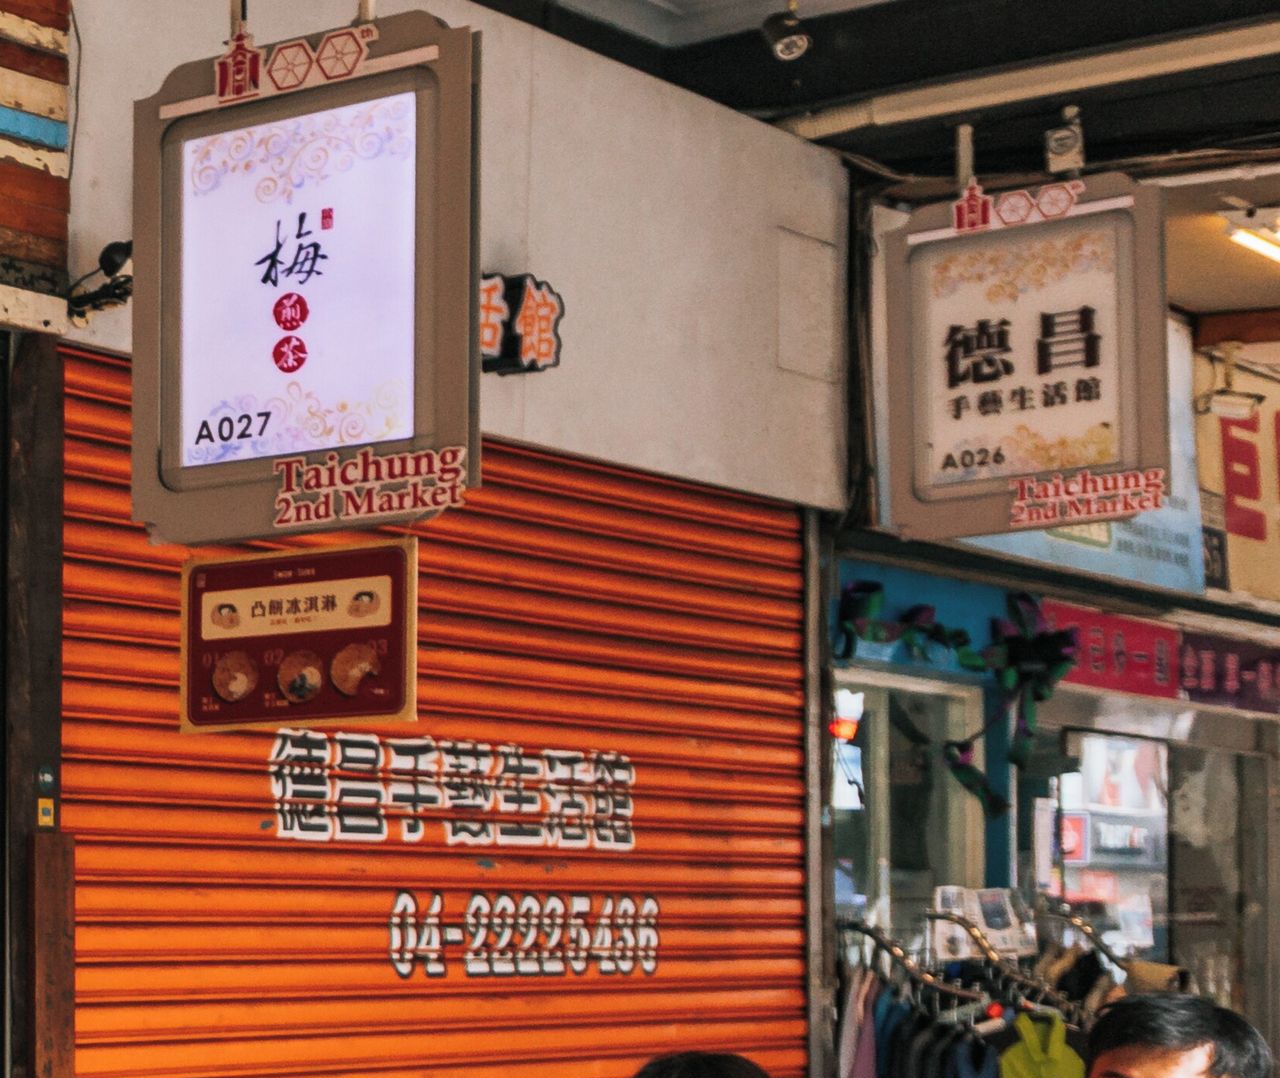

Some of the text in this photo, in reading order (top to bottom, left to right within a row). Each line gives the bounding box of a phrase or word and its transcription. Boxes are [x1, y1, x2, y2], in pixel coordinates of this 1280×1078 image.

[943, 305, 1102, 389] 德昌
[948, 376, 1102, 419] 手藝生活館
[194, 411, 273, 446] A027
[277, 447, 462, 494] Taichung
[941, 448, 1006, 471] A026
[276, 482, 461, 525] 2nd Market
[1011, 470, 1164, 503] Taichung
[1011, 494, 1163, 525] 2nd Market
[268, 727, 636, 851] 德昌手藝生活館
